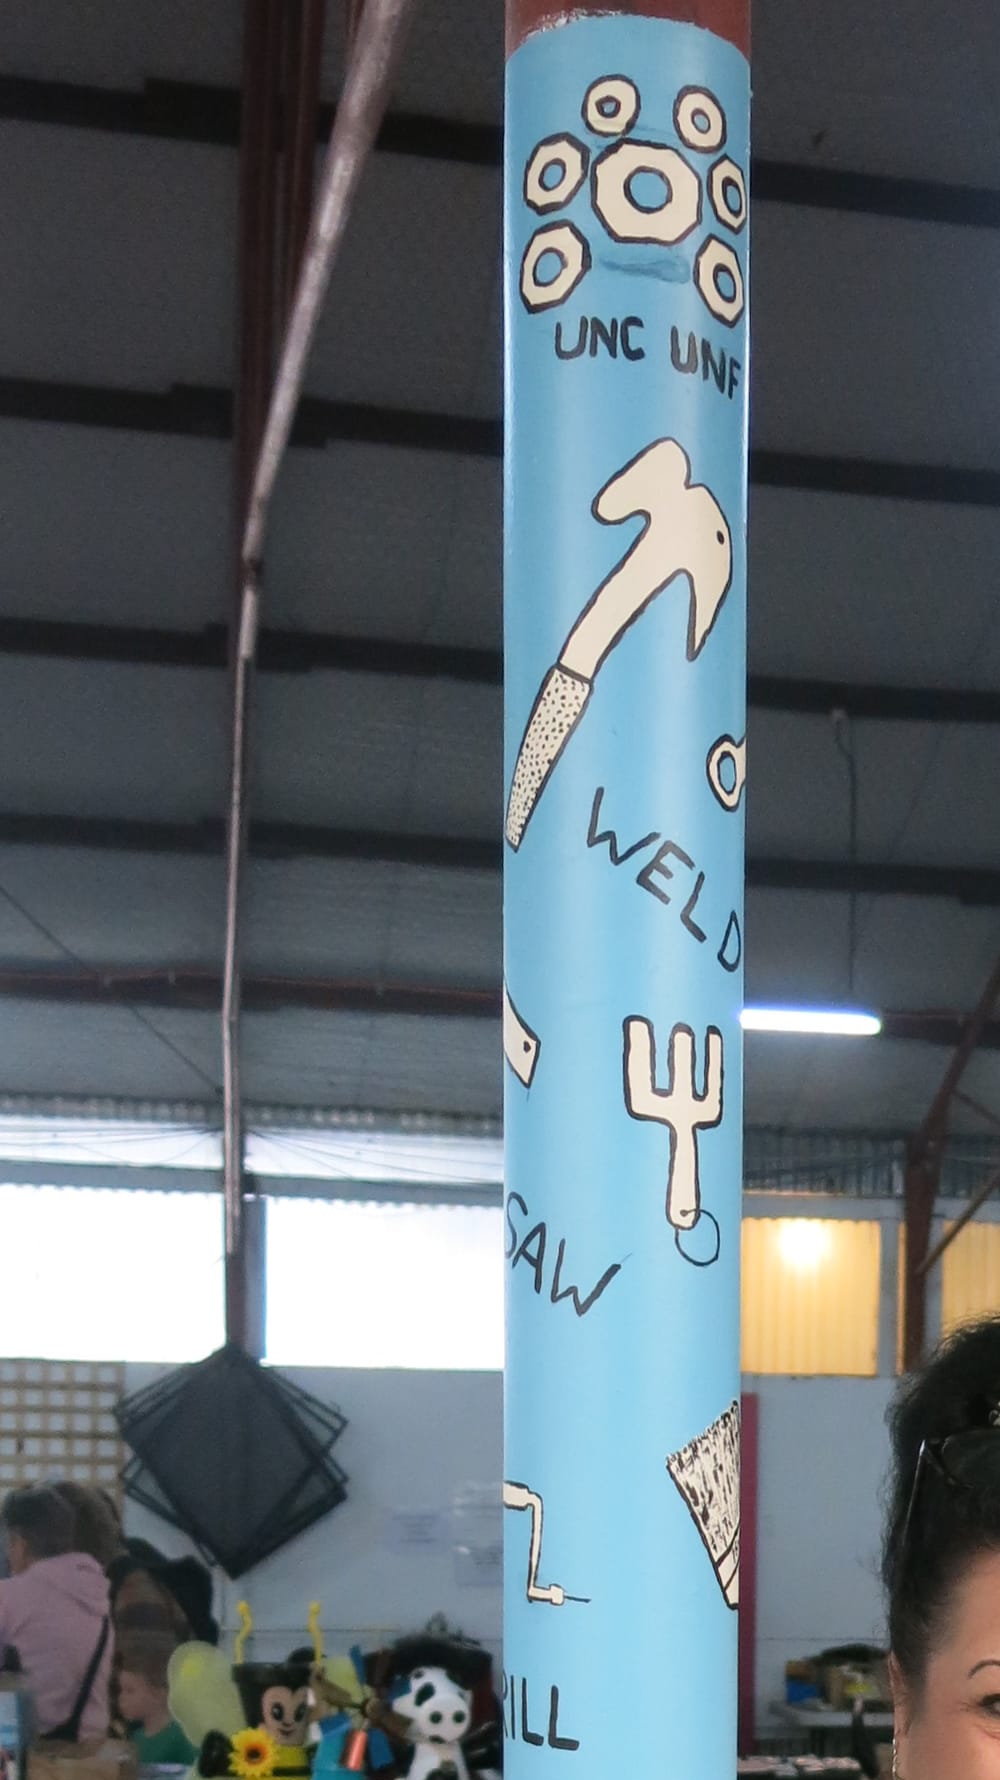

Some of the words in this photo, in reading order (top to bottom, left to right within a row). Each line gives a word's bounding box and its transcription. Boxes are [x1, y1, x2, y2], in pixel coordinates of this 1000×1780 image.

[554, 315, 646, 361] UNC
[669, 325, 742, 399] UNF
[586, 786, 742, 971] WELD
[504, 1191, 622, 1317] SAW
